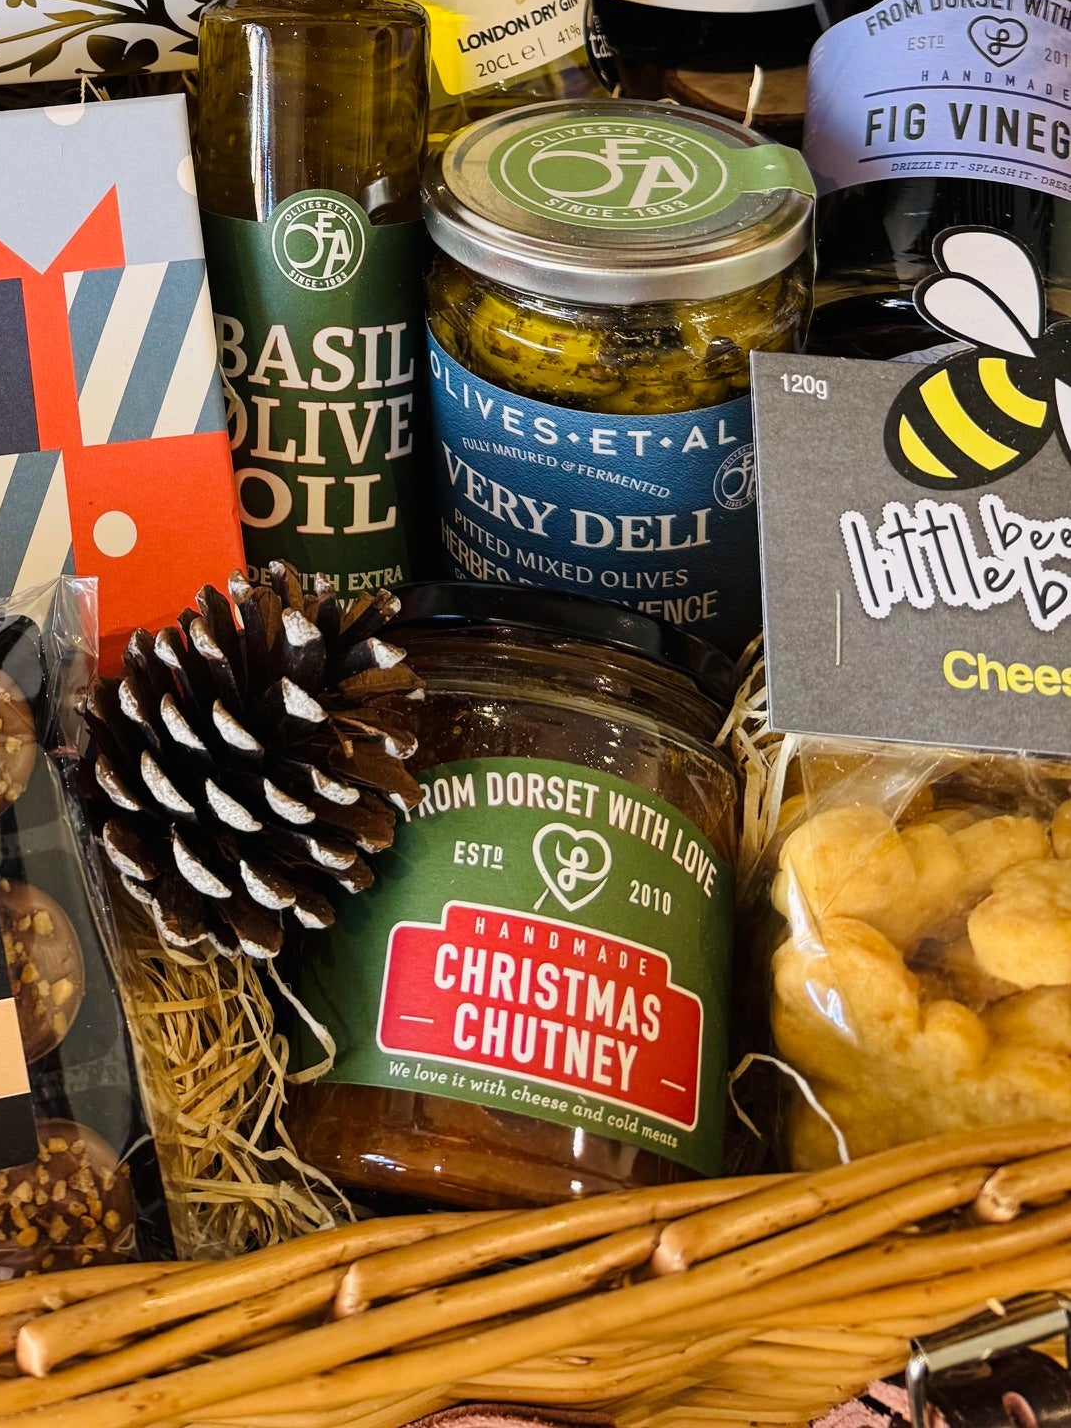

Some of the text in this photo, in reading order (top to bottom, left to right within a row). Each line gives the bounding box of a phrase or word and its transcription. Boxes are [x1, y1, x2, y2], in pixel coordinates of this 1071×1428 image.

[457, 15, 531, 54] LONDON
[531, 1, 561, 27] DRY
[475, 56, 519, 78] 20CL
[556, 24, 582, 46] 41%
[921, 70, 1070, 101] HANDMADE
[531, 125, 610, 148] OLIVES
[864, 102, 1071, 161] FIG VINEG
[891, 160, 1032, 181] DRIZZLE IT SPLASH IT
[284, 201, 322, 221] OLIVES
[544, 197, 690, 219] SINCE 1993
[288, 269, 318, 288] SINCE
[214, 312, 415, 393] BASIL
[429, 350, 559, 446] OLIVES
[779, 373, 828, 400] 120g
[442, 441, 712, 553] VERY DELI
[462, 437, 670, 499] FULLY MATURED & FERMENTED
[233, 467, 397, 535] OIL
[347, 564, 403, 591] EXTRA
[454, 507, 510, 559] PITTED
[516, 546, 594, 584] MIXED
[600, 569, 689, 589] OLIVES
[850, 509, 1016, 609] little
[486, 771, 718, 899] DORSET WITH LOVE
[629, 879, 673, 916] 2010
[474, 916, 648, 977] HANDMADE
[433, 943, 661, 1043] CHRISTMAS
[452, 1002, 639, 1093] CHUTNEY
[388, 1060, 679, 1150] We love it with cheese and cold meats
